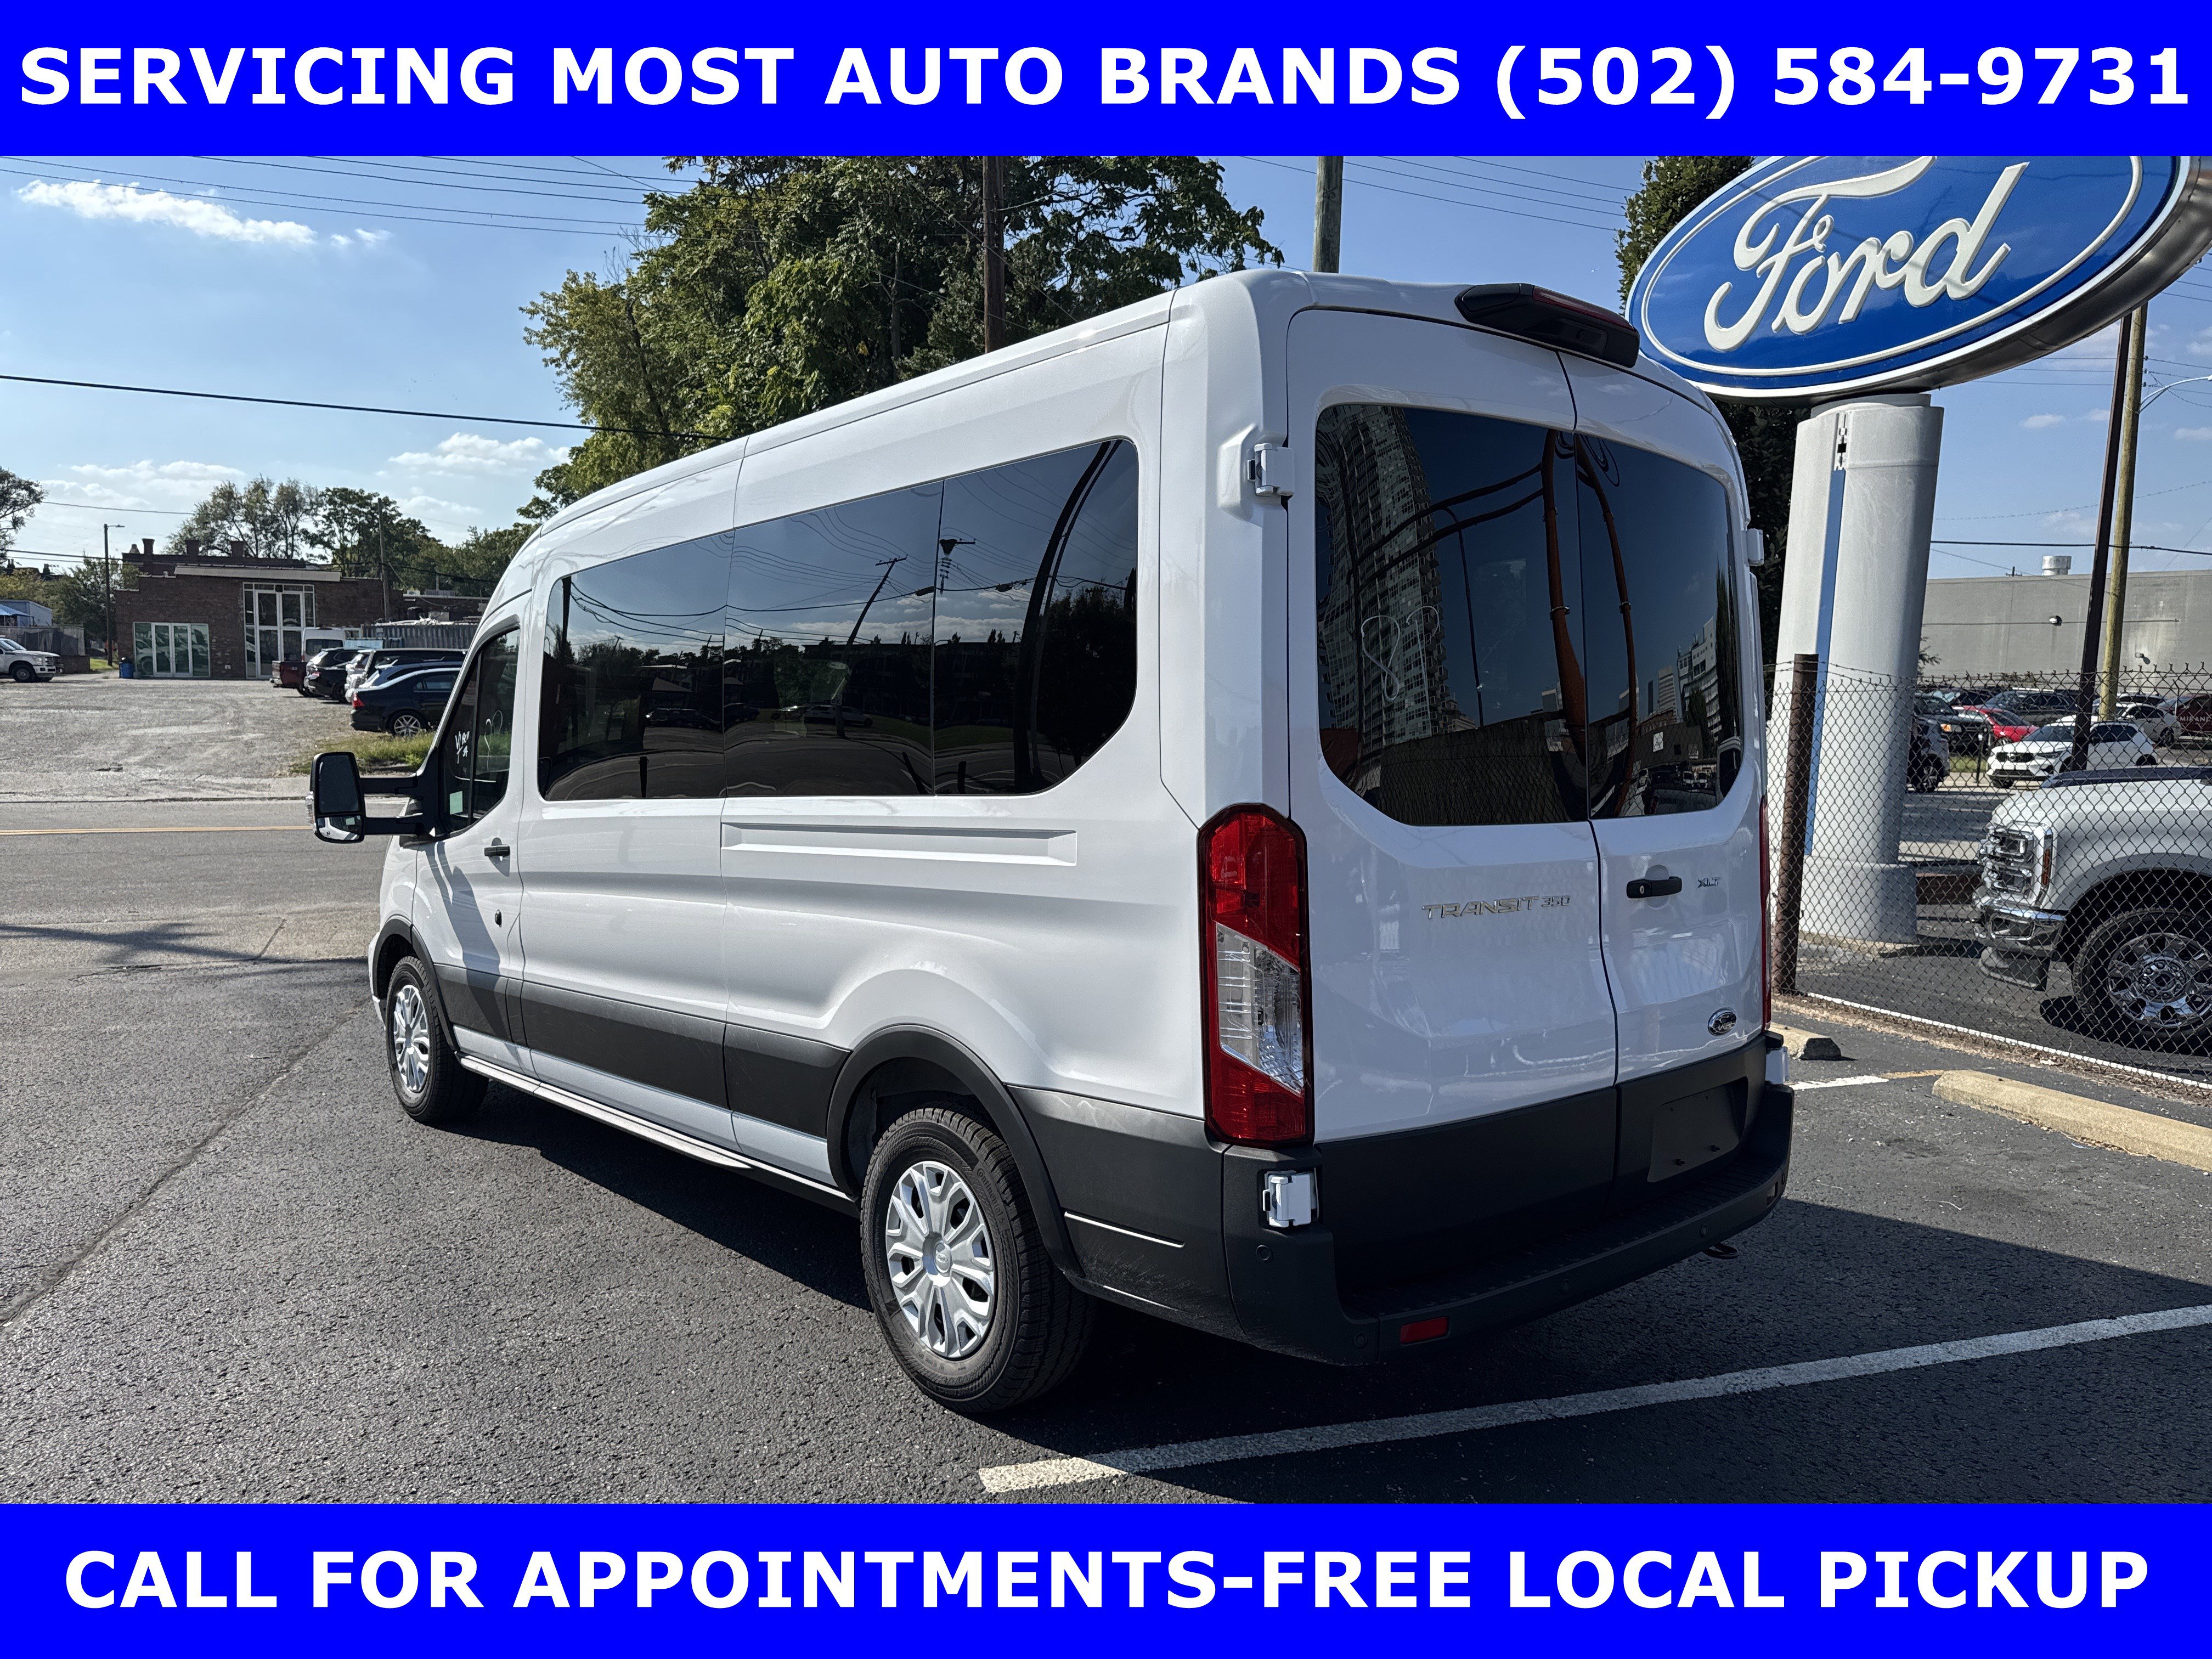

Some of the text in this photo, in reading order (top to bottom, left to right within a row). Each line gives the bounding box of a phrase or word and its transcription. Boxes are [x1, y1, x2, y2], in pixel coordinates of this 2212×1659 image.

[1703, 156, 2030, 352] Ford
[1697, 876, 1722, 888] XLT
[1421, 894, 1571, 919] TRANSIT 350
[977, 1167, 1004, 1217] Continental
